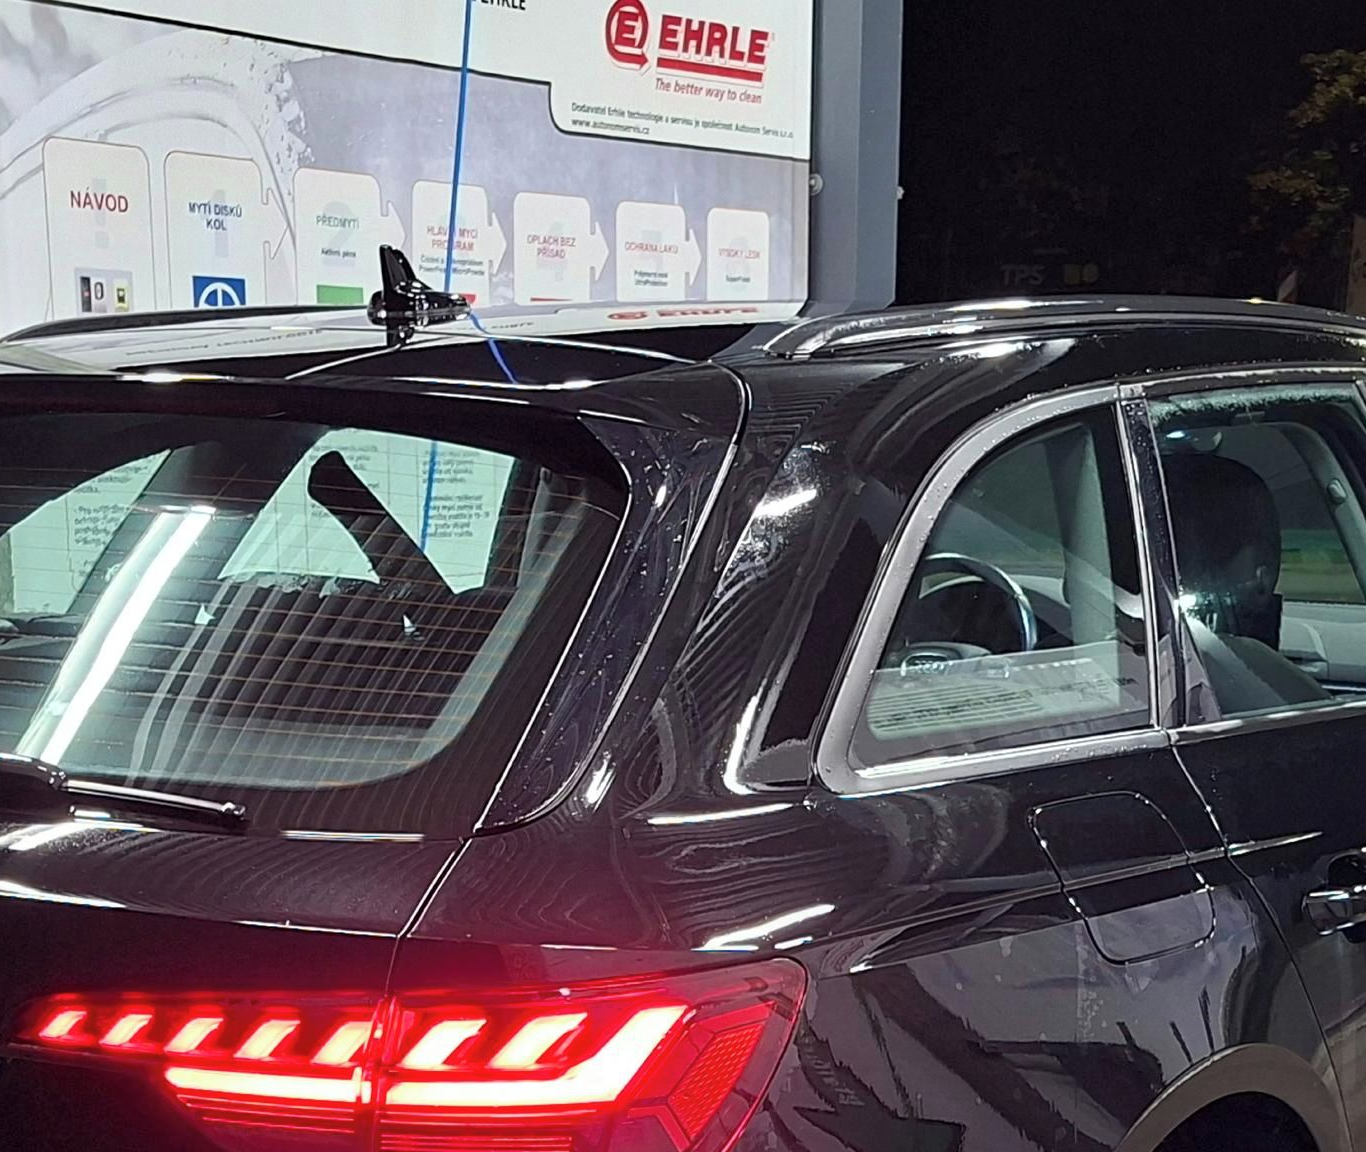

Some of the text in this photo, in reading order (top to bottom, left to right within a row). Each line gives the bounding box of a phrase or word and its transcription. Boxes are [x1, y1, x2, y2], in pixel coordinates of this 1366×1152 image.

[659, 14, 769, 65] EHRLE
[656, 78, 762, 104] The better way to clean
[70, 186, 129, 213] NÁVOD
[188, 200, 243, 218] MYTÍ DISKŮ
[206, 218, 227, 231] KOL
[316, 212, 360, 229] PŘEDMYTÍ
[432, 239, 474, 252] PRORAM
[527, 234, 577, 248] OPLACH BEZ
[625, 241, 679, 255] OCHRANA LAKU
